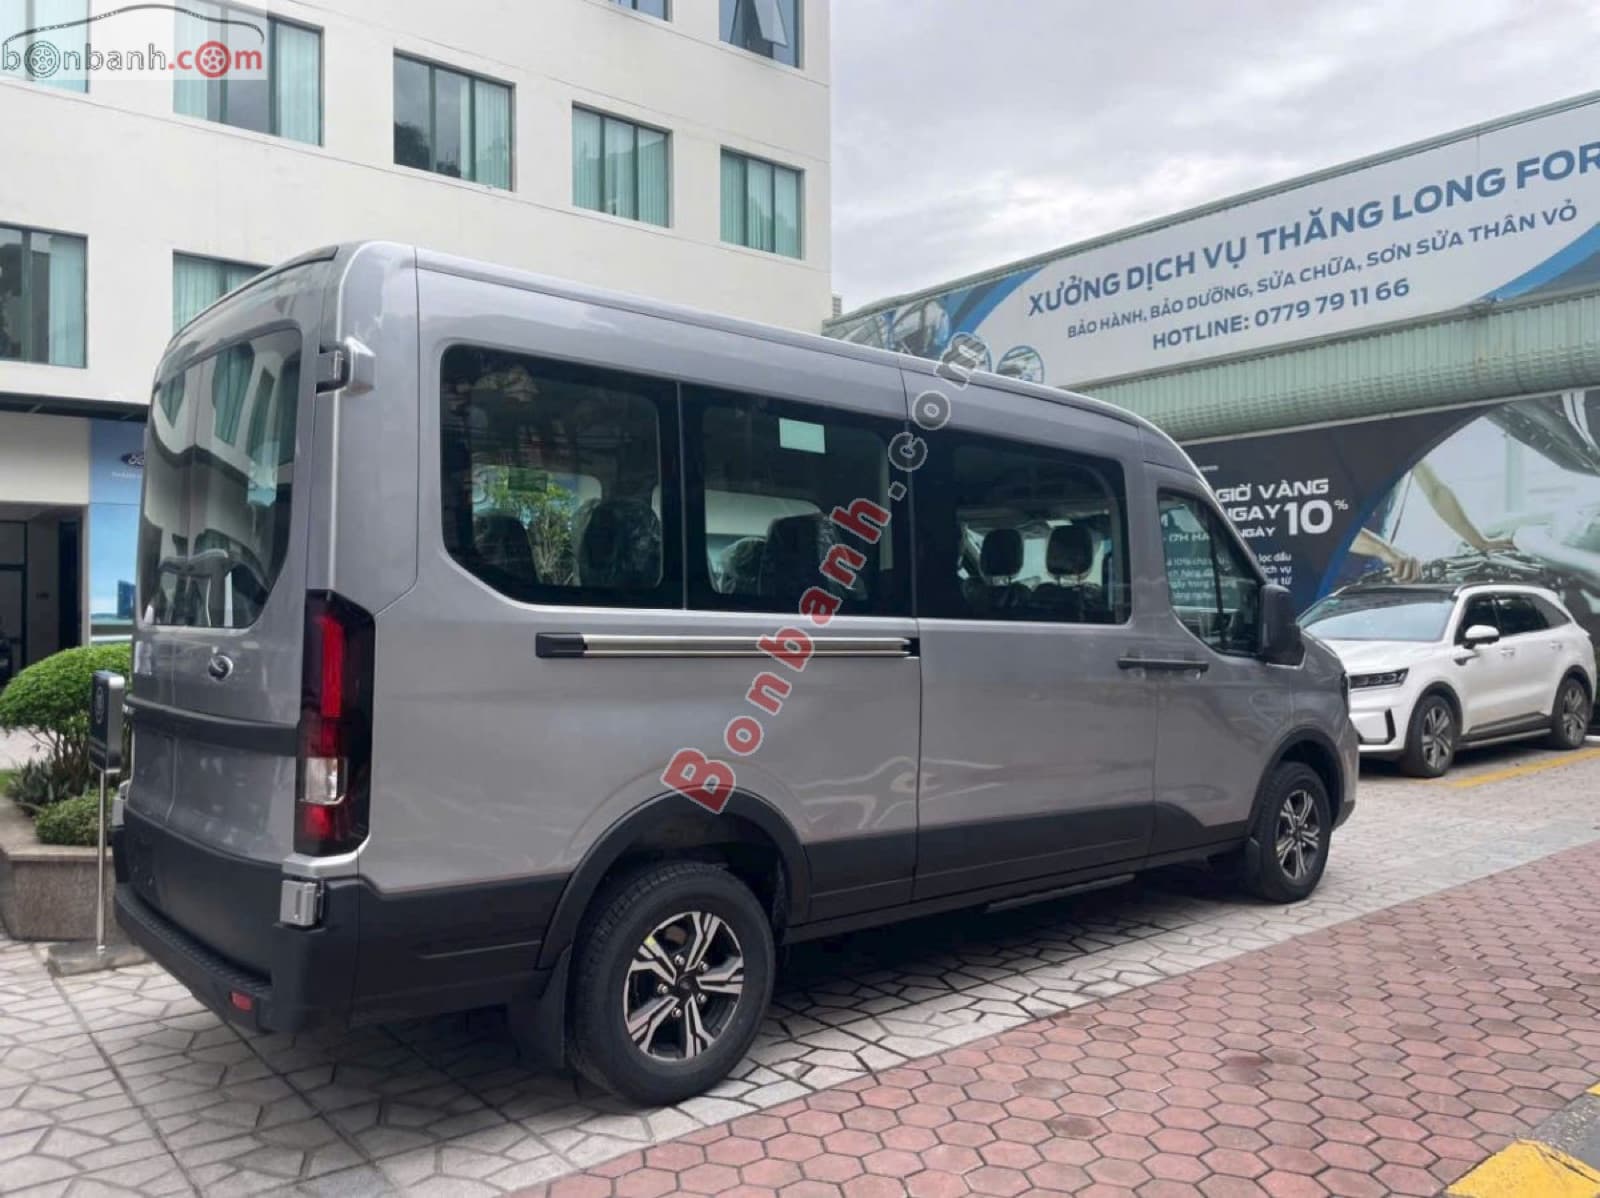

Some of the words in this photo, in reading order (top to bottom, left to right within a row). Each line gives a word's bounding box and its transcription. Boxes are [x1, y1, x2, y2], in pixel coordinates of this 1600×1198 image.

[1028, 273, 1120, 317] XƯỞNG
[1126, 251, 1196, 292] DỊCH
[1203, 236, 1248, 269] VỤ
[1256, 206, 1384, 255] THĂNG
[1393, 168, 1506, 222] LONG
[1067, 318, 1097, 338] BẢO
[1099, 309, 1147, 331] HÀNH,
[1150, 298, 1184, 319] BẢO
[1187, 281, 1253, 310] DƯỠNG,
[1257, 269, 1296, 294] SỬA
[1299, 256, 1362, 283] CHỮA,
[1366, 242, 1412, 268] SƠN
[1416, 229, 1464, 256] SỬA
[1468, 213, 1536, 244] THÂN
[1542, 198, 1578, 227] VỎ
[1152, 314, 1250, 351] HOTLINE:
[1254, 298, 1311, 327] 0779
[1314, 291, 1346, 315] 79
[1350, 286, 1370, 308] 11
[1375, 277, 1410, 301] 66
[1258, 477, 1329, 500] VÀNG
